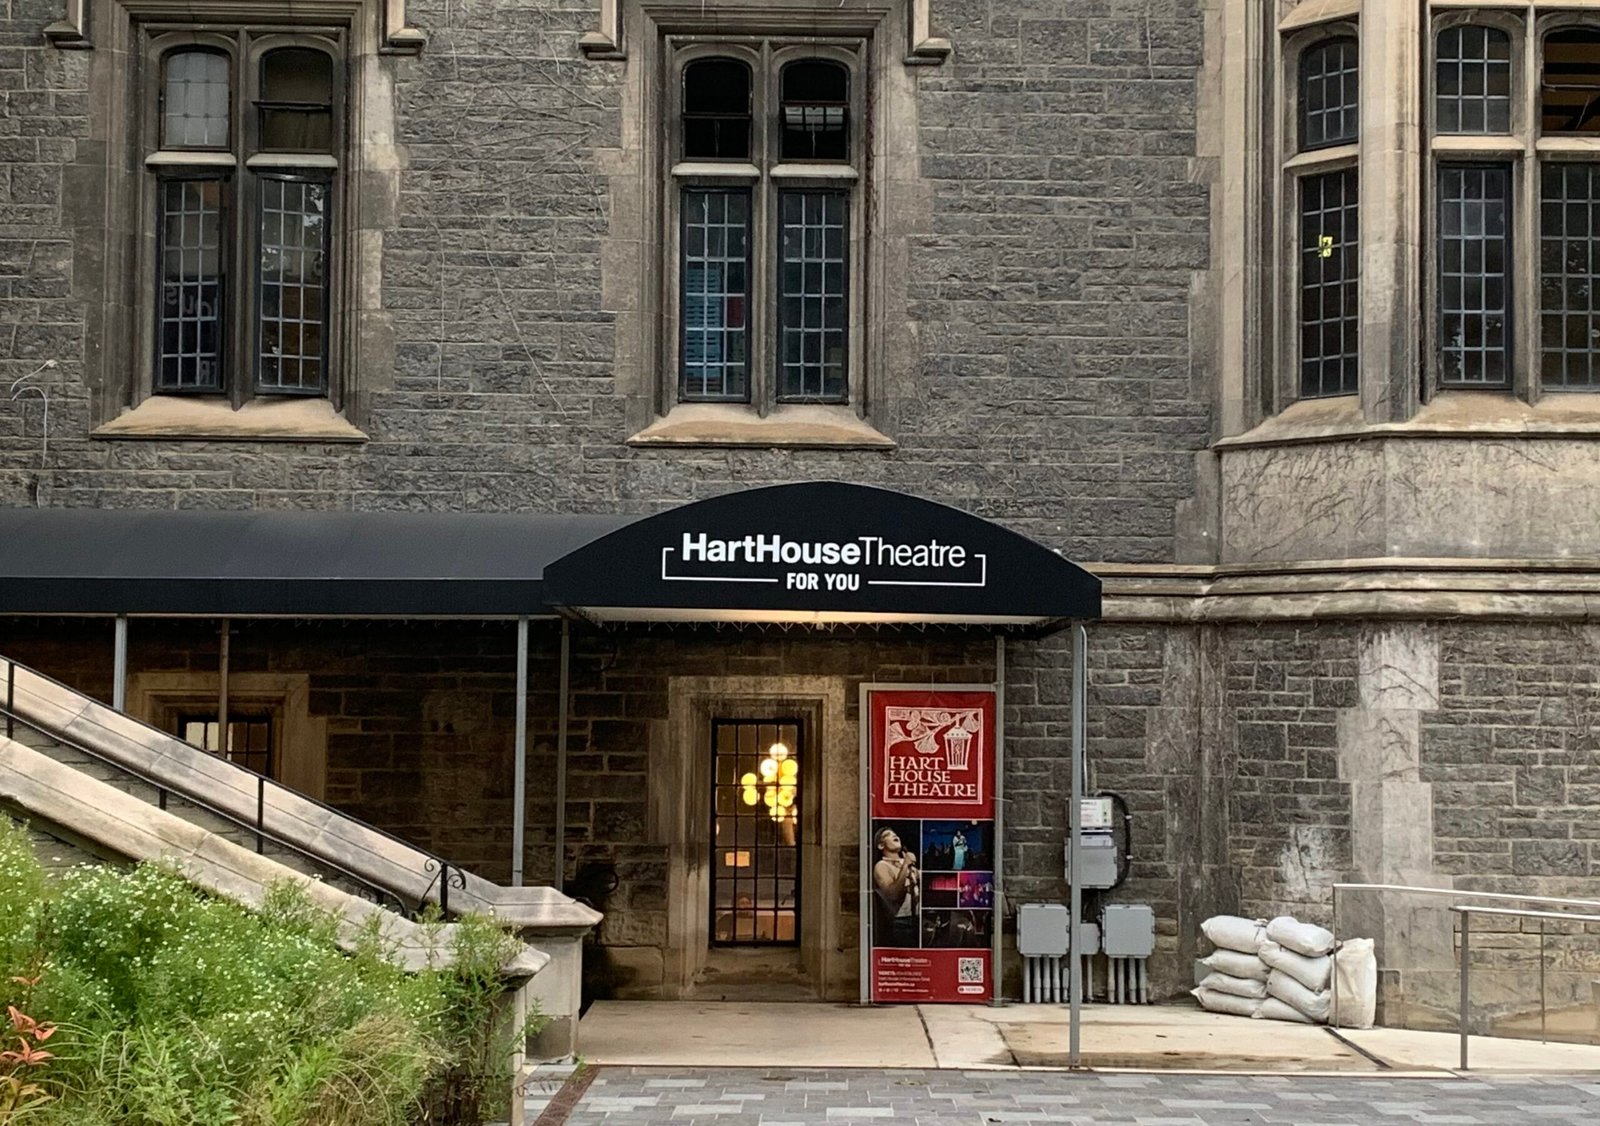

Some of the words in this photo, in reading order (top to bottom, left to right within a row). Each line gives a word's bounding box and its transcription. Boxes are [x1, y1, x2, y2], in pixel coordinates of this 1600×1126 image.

[682, 533, 966, 567] HartHouseTheatre
[786, 572, 819, 590] FOR
[824, 573, 860, 591] YOU
[889, 756, 945, 770] HART
[889, 769, 951, 783] HOUSE
[888, 782, 977, 797] THEATRE
